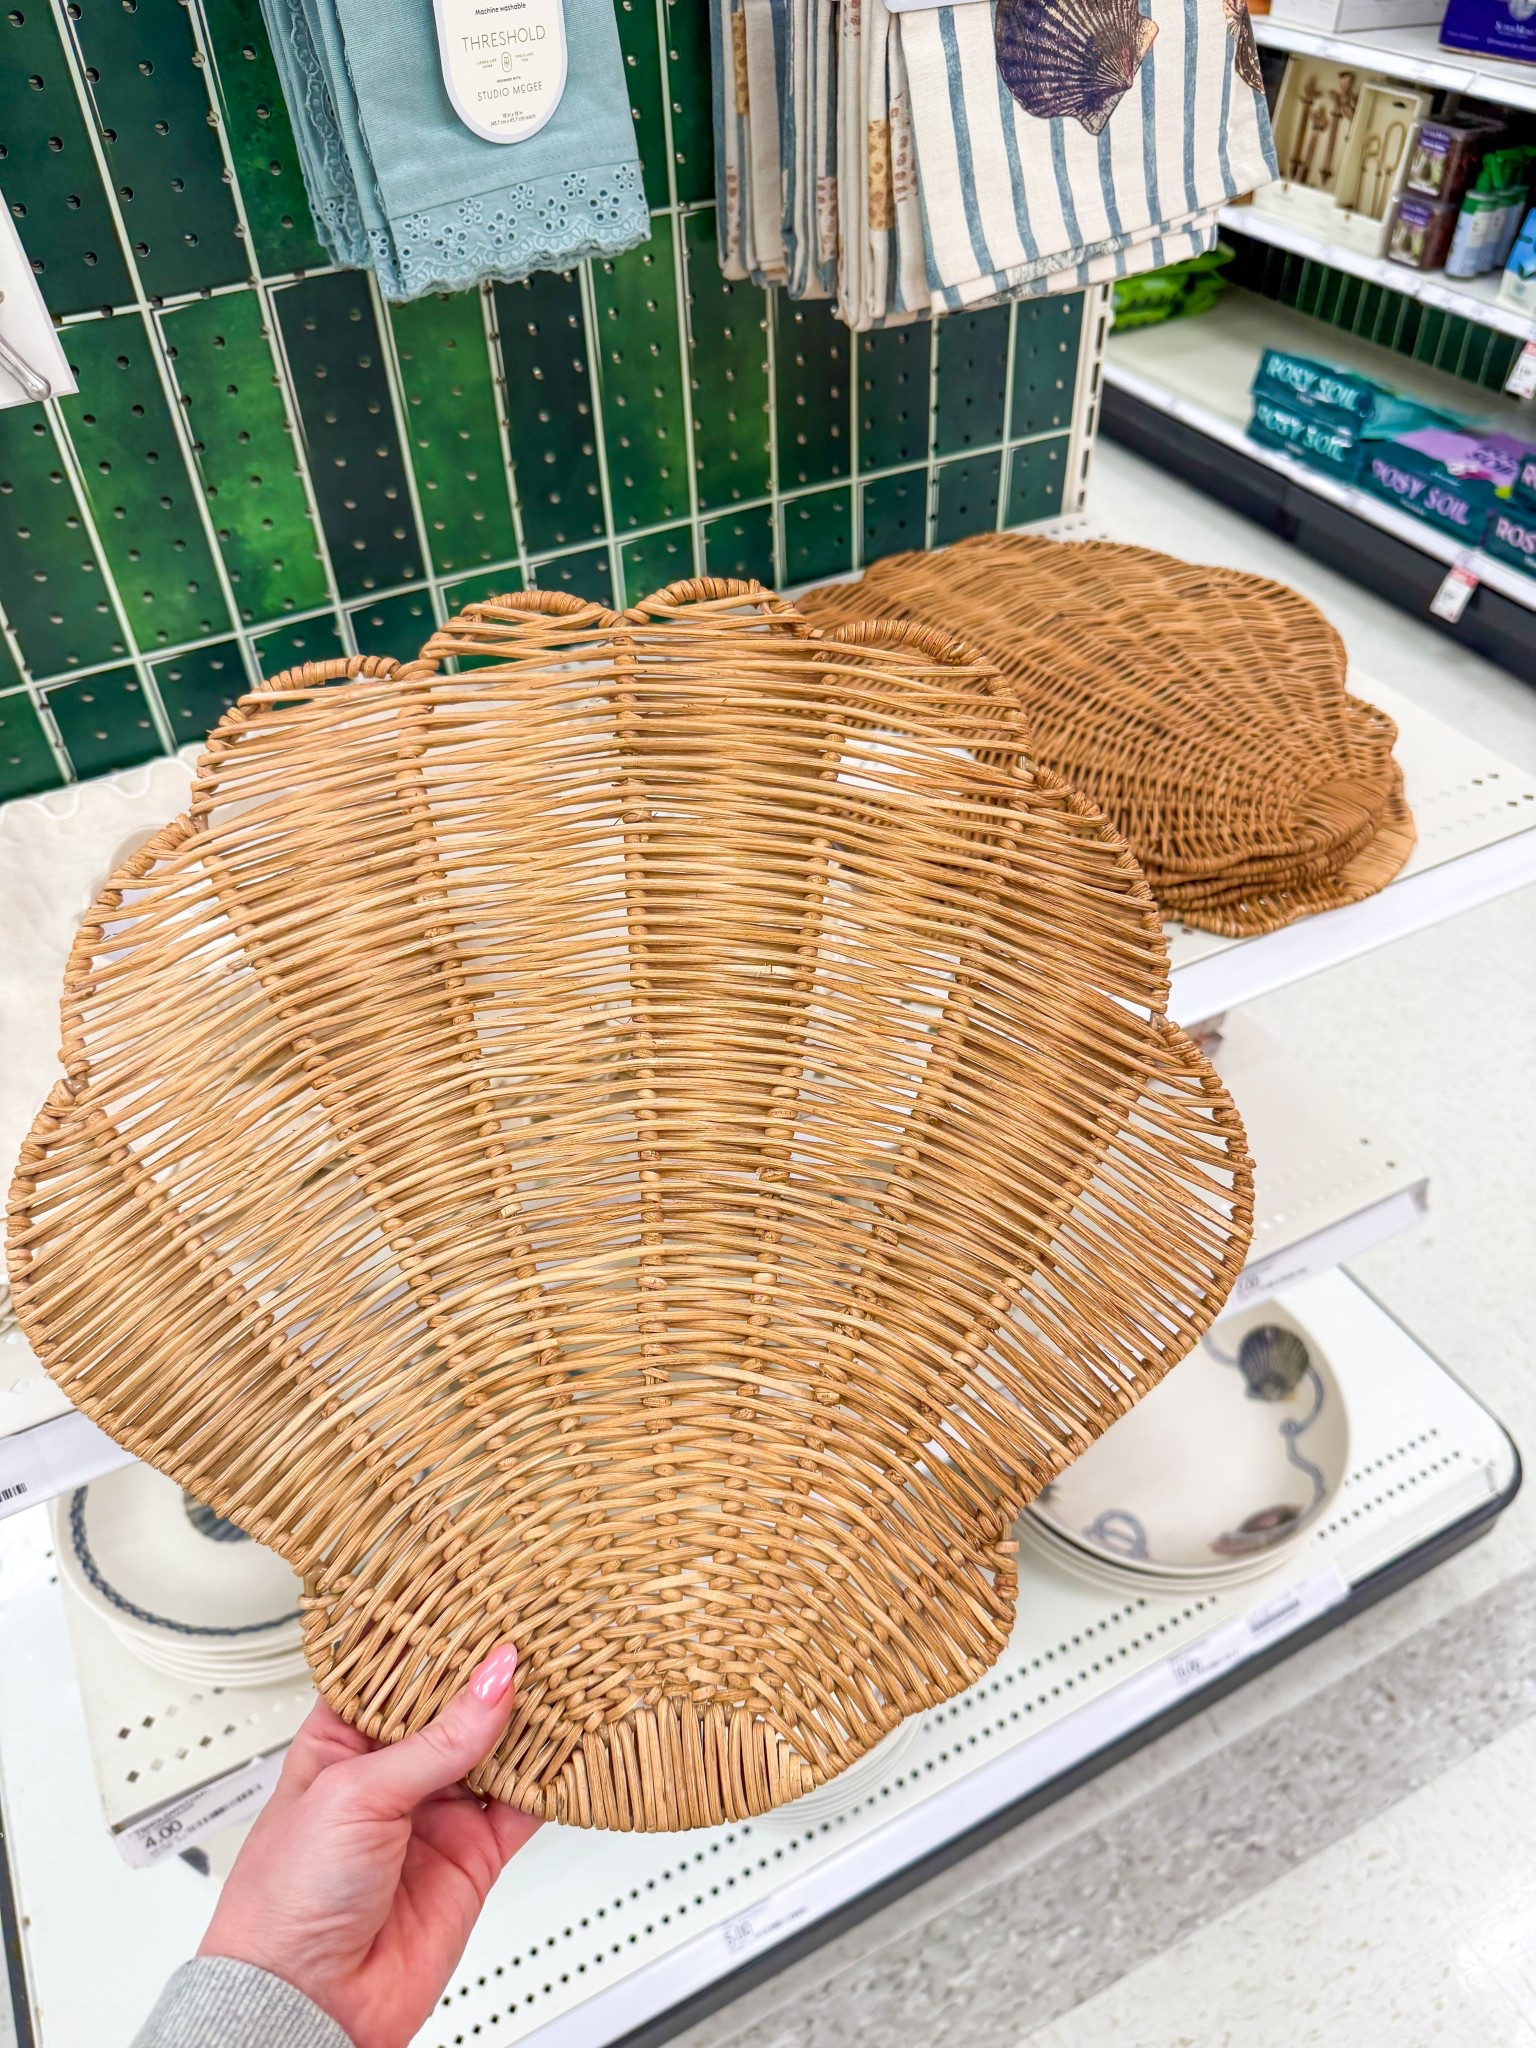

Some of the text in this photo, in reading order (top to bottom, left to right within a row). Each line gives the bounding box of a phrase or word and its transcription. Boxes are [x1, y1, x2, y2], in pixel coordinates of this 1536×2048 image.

[475, 2, 526, 15] Machine washable
[461, 25, 546, 52] THRESHOLD
[477, 87, 509, 101] STUDIO
[1266, 355, 1319, 393] ROSY
[1312, 378, 1359, 411] SOIL
[1257, 404, 1306, 440] ROSY
[1302, 425, 1351, 462] SOIL
[1372, 458, 1427, 500] ROSY
[1423, 486, 1470, 525] SOIL
[145, 1819, 183, 1849] 4.00
